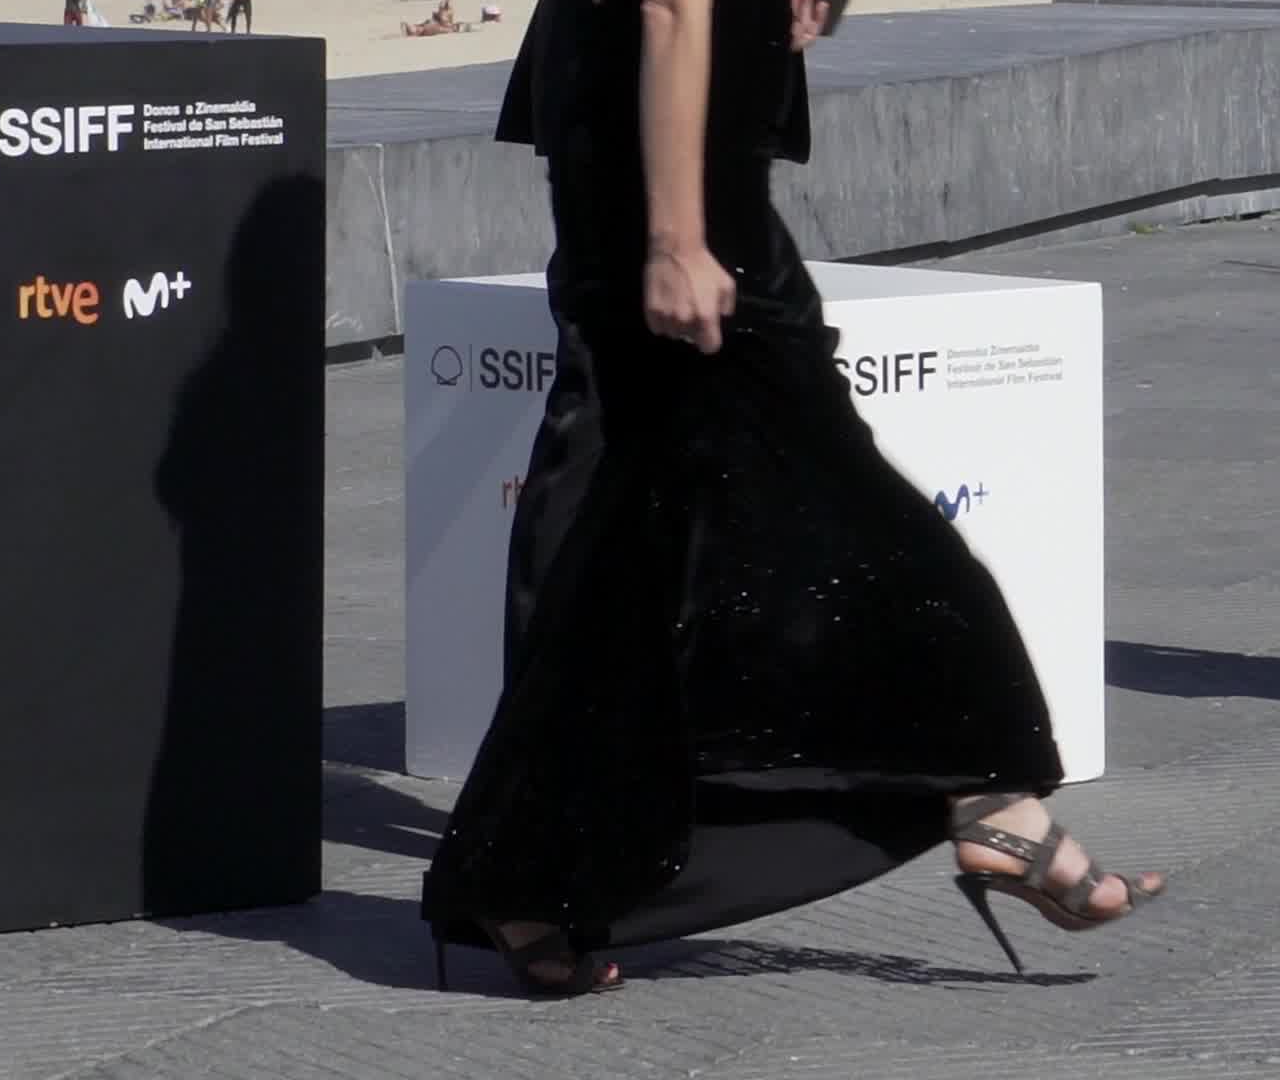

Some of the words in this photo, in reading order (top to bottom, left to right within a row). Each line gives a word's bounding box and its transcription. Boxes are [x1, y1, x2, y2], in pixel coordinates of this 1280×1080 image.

[143, 119, 187, 133] Festival
[188, 119, 203, 131] de
[205, 117, 227, 131] San
[143, 135, 213, 150] International
[215, 134, 240, 147] Film
[241, 132, 284, 145] Festival
[18, 275, 100, 325] rtve
